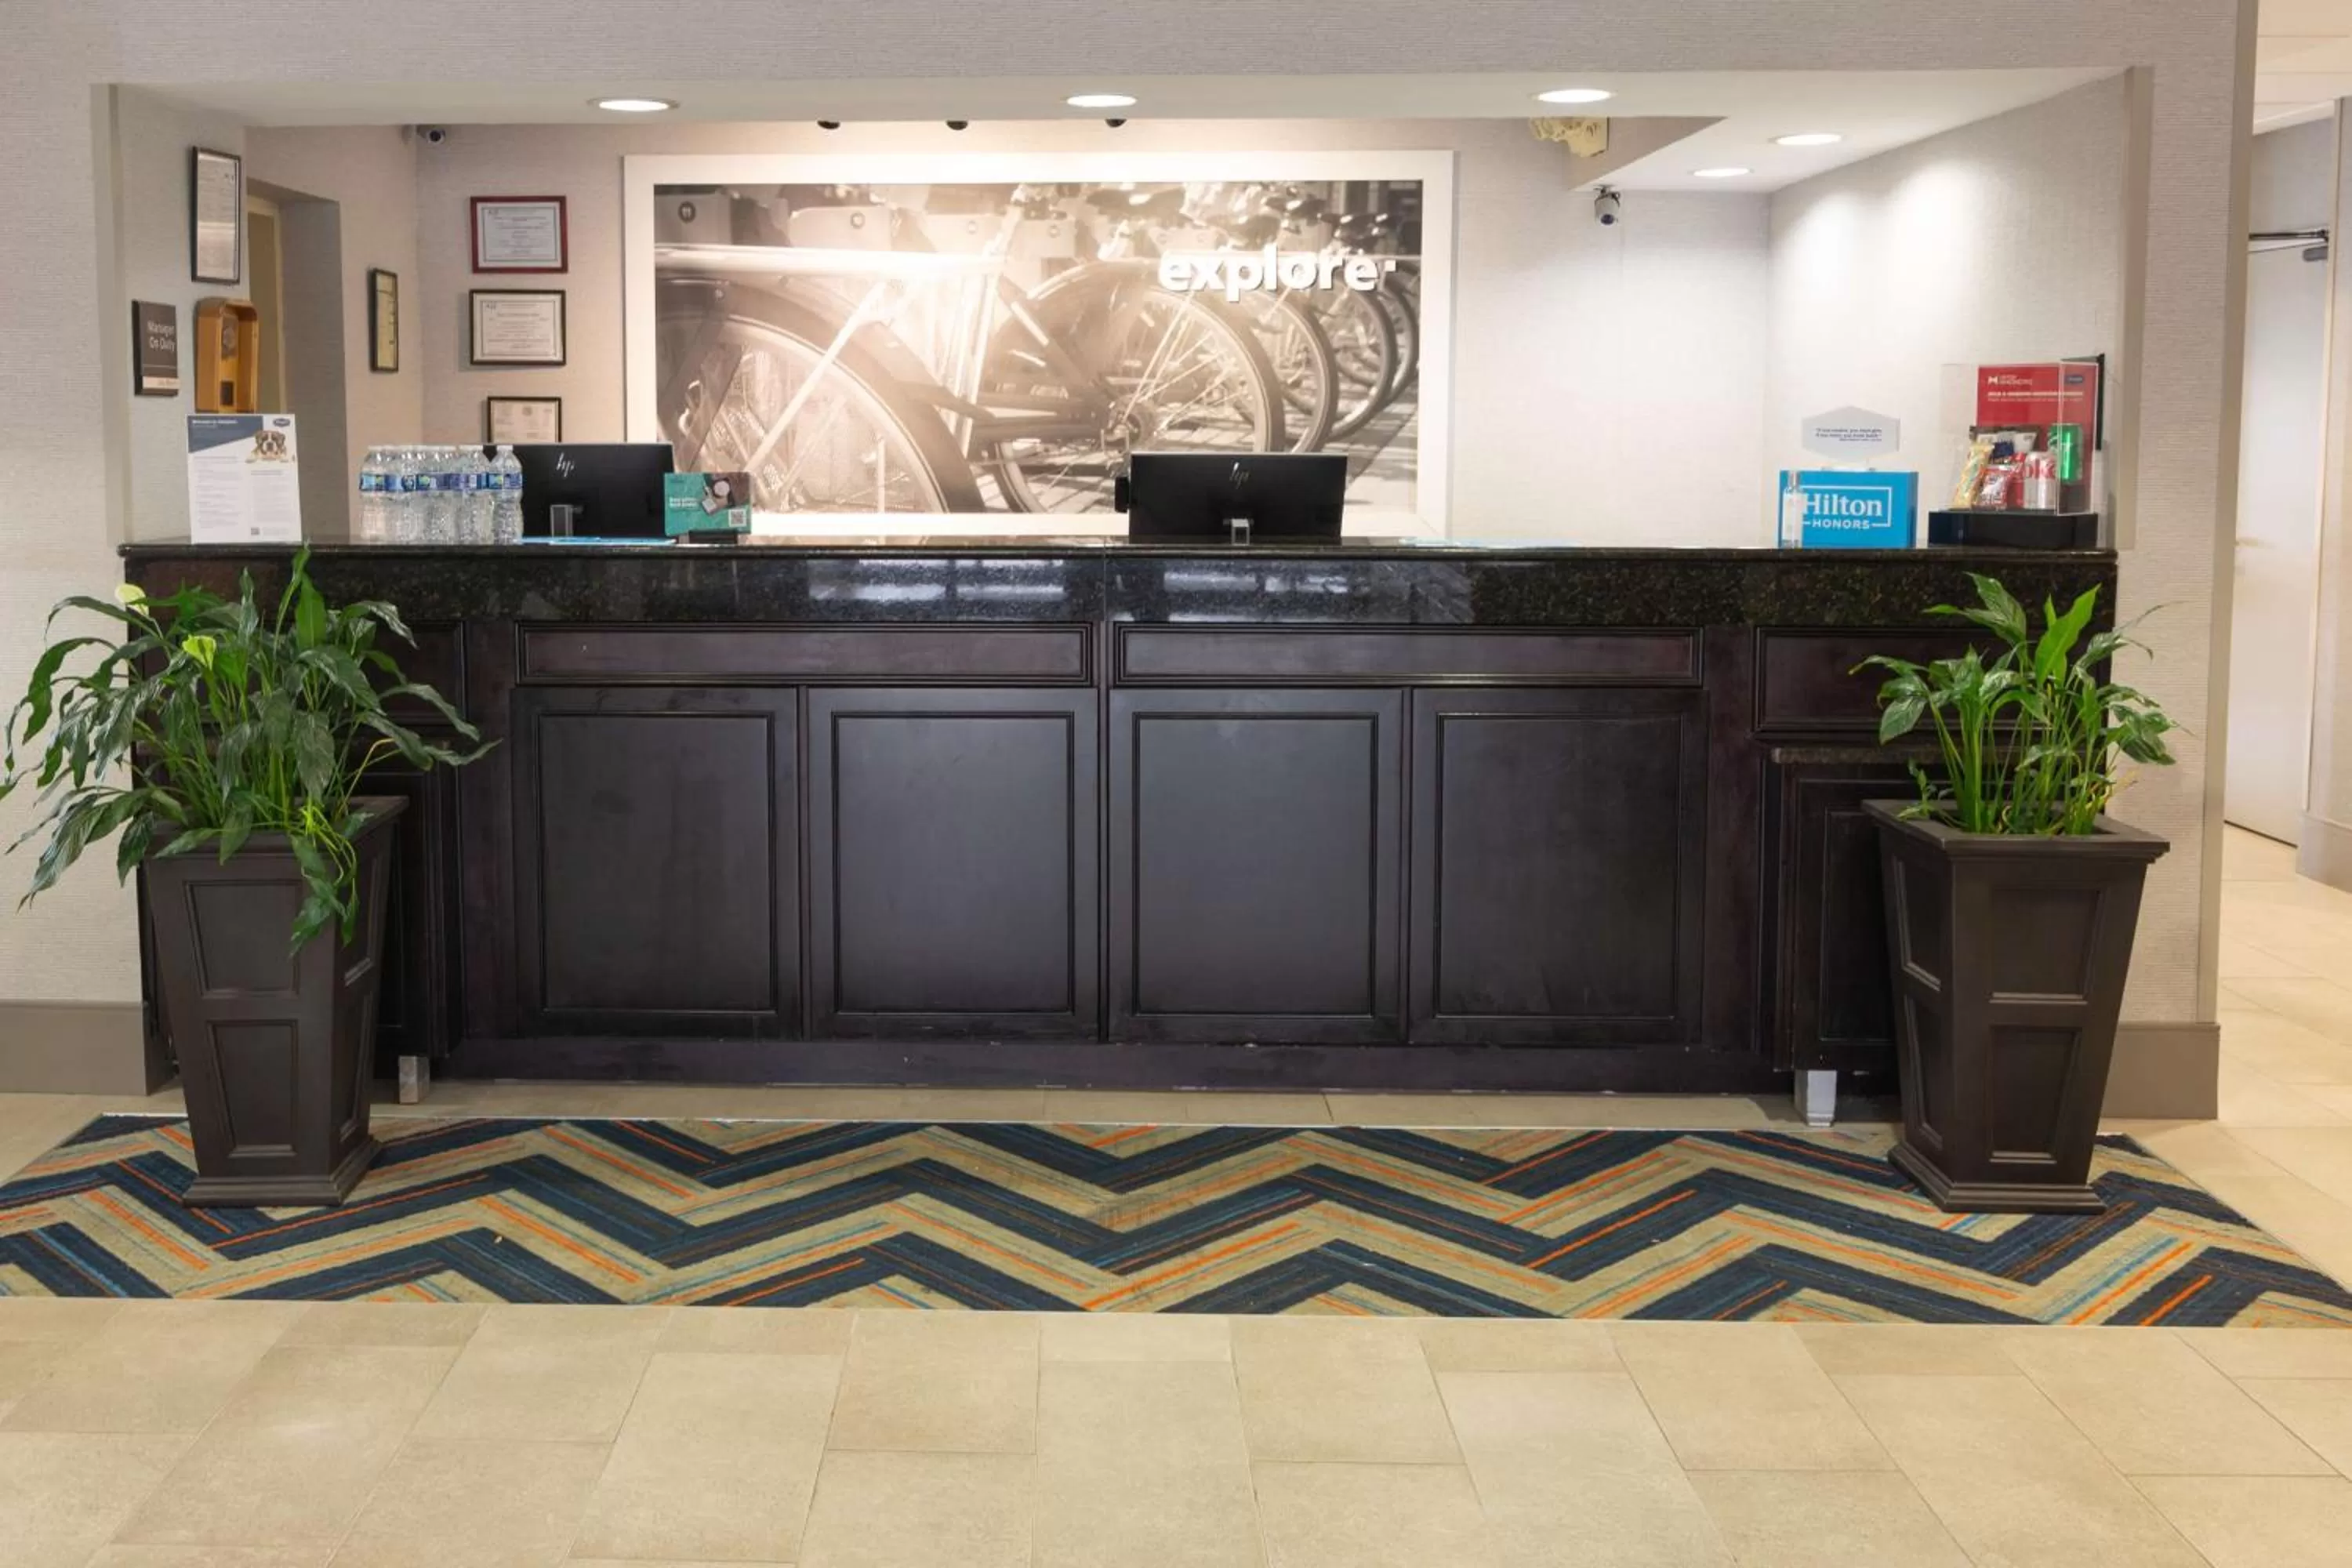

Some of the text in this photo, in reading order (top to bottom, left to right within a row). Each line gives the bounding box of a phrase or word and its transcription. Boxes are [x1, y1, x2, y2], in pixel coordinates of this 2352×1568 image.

[1159, 243, 1379, 303] explore
[147, 321, 175, 337] Manager
[556, 452, 575, 477] hp
[1229, 462, 1250, 489] hp
[1803, 492, 1882, 517] Hilton
[1812, 517, 1870, 530] HONORS
